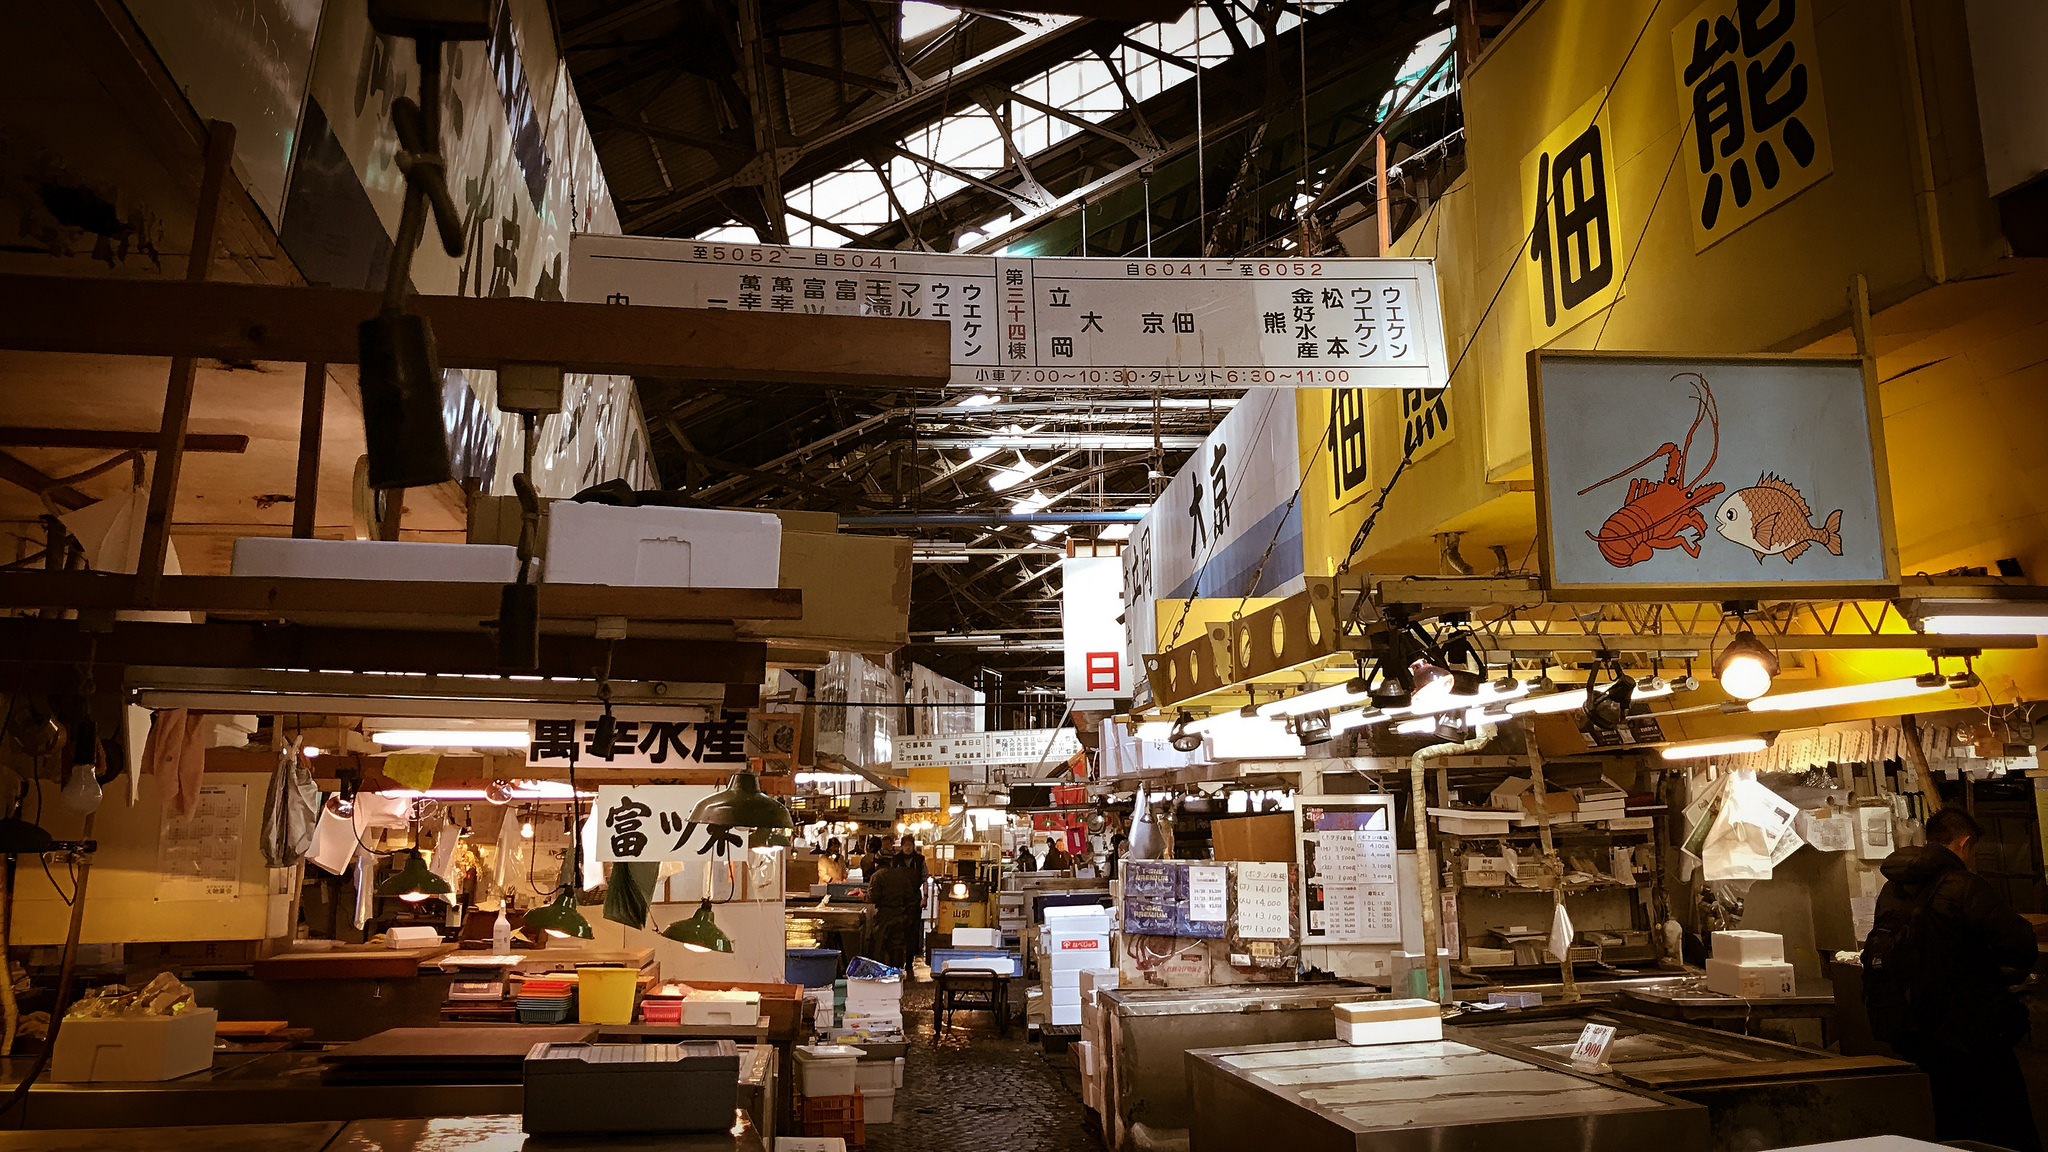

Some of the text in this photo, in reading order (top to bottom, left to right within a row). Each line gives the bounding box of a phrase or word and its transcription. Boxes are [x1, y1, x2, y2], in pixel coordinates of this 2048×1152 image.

[1530, 0, 1817, 327] 佃 熊
[961, 284, 983, 358] ウエケン
[1005, 268, 1027, 360] 第三十四棟
[1291, 287, 1319, 359] 金好水産
